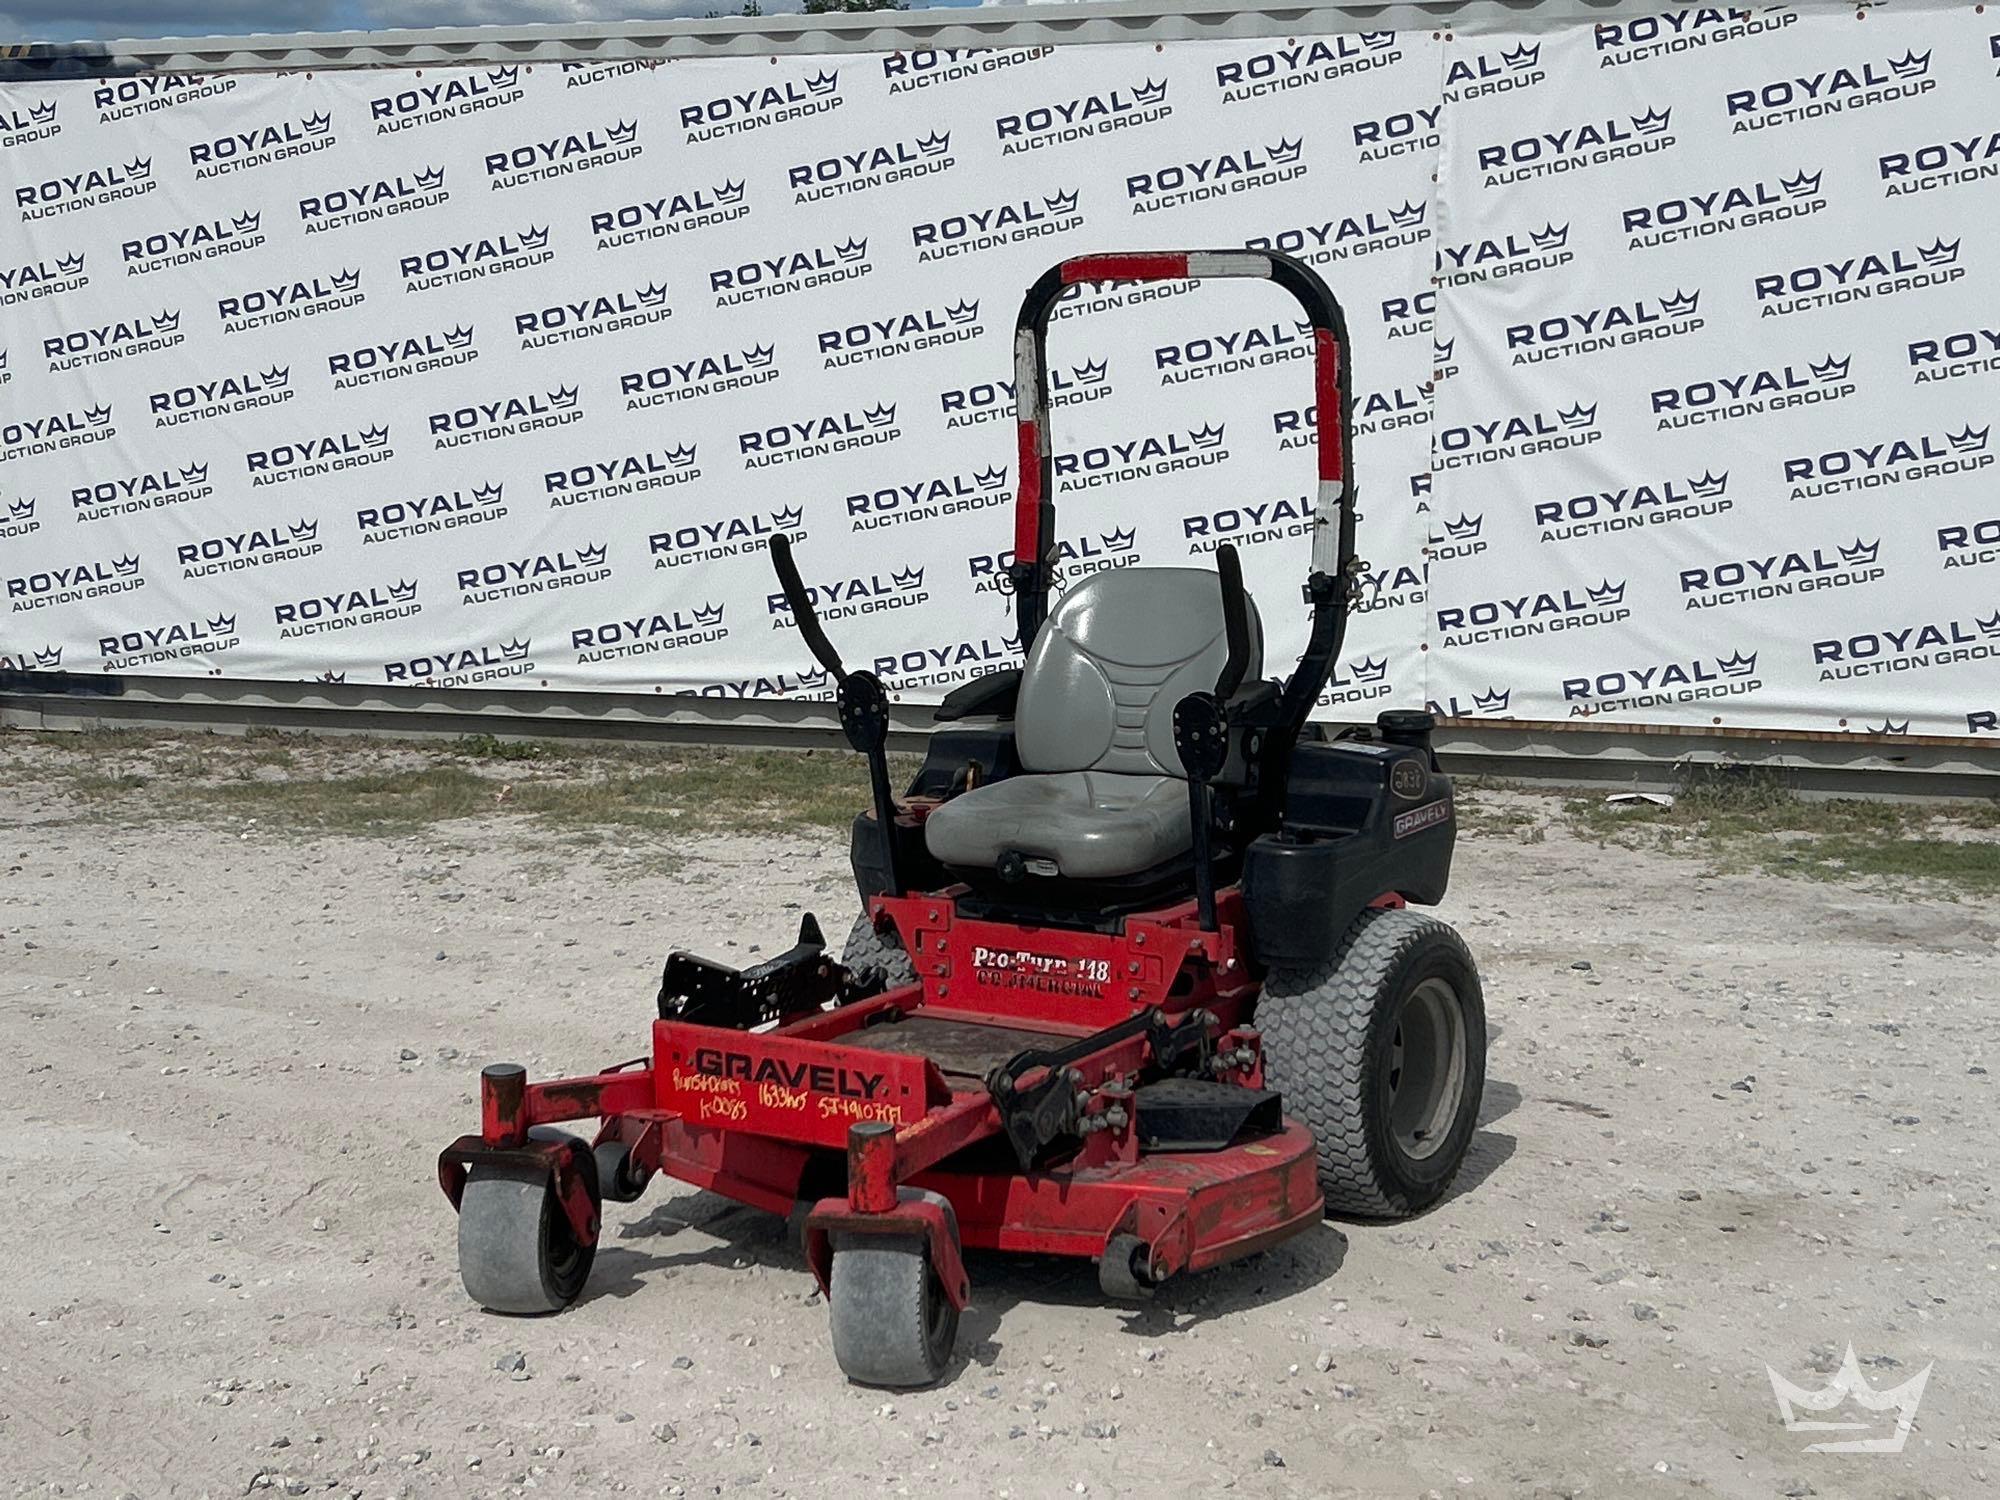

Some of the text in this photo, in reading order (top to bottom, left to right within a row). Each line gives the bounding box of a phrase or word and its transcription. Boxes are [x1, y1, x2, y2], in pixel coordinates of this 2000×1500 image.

[1216, 36, 1360, 87] ROYAL
[1222, 51, 1402, 104] AUCTION GROUP
[370, 76, 489, 120] ROYAL
[680, 82, 806, 128] ROYAL
[1727, 63, 1889, 116] ROYAL
[1733, 79, 1936, 134] AUCTION GROUP
[377, 90, 524, 135] AUCTION GROUP
[687, 97, 843, 144] AUCTION GROUP
[996, 91, 1132, 139] ROYAL
[1003, 106, 1172, 156] AUCTION GROUP
[189, 123, 302, 165] ROYAL
[196, 137, 335, 180] AUCTION GROUP
[485, 131, 607, 175] ROYAL
[1478, 120, 1631, 171] ROYAL
[1484, 136, 1675, 188] AUCTION GROUP
[16, 167, 125, 207] ROYAL
[492, 146, 642, 191] AUCTION GROUP
[789, 143, 917, 189] ROYAL
[795, 158, 955, 205] AUCTION GROUP
[1126, 150, 1266, 198] ROYAL
[22, 181, 156, 222] AUCTION GROUP
[299, 177, 415, 219] ROYAL
[1133, 165, 1307, 215] AUCTION GROUP
[1623, 183, 1780, 233] ROYAL
[305, 192, 449, 234] AUCTION GROUP
[591, 191, 714, 235] ROYAL
[597, 206, 750, 250] AUCTION GROUP
[912, 201, 1045, 247] ROYAL
[1629, 200, 1826, 251] AUCTION GROUP
[122, 221, 233, 262] ROYAL
[128, 235, 265, 276] AUCTION GROUP
[400, 236, 519, 278] ROYAL
[919, 216, 1083, 263] AUCTION GROUP
[406, 251, 554, 293] AUCTION GROUP
[710, 249, 835, 292] ROYAL
[716, 264, 872, 308] AUCTION GROUP
[1755, 251, 1917, 300] ROYAL
[218, 279, 332, 319] ROYAL
[224, 294, 365, 334] AUCTION GROUP
[515, 293, 637, 335] ROYAL
[1761, 268, 1965, 318] AUCTION GROUP
[43, 320, 153, 358] ROYAL
[522, 309, 672, 350] AUCTION GROUP
[818, 310, 946, 353] ROYAL
[1506, 301, 1660, 349] ROYAL
[1512, 319, 1704, 366] AUCTION GROUP
[49, 334, 184, 373] AUCTION GROUP
[328, 335, 445, 375] ROYAL
[824, 326, 984, 370] AUCTION GROUP
[1155, 324, 1295, 369] ROYAL
[335, 350, 478, 390] AUCTION GROUP
[621, 354, 743, 395] ROYAL
[627, 370, 779, 411] AUCTION GROUP
[1651, 367, 1809, 413] ROYAL
[149, 375, 262, 414] ROYAL
[156, 390, 293, 428] AUCTION GROUP
[429, 395, 549, 435] ROYAL
[1657, 384, 1855, 431] AUCTION GROUP
[435, 411, 583, 450] AUCTION GROUP
[739, 413, 864, 454] ROYAL
[745, 429, 901, 470] AUCTION GROUP
[1431, 413, 1558, 454] OYAL
[247, 434, 360, 472] ROYAL
[253, 450, 394, 487] AUCTION GROUP
[544, 454, 666, 493] ROYAL
[1054, 434, 1189, 476] ROYAL
[1060, 451, 1229, 493] AUCTION GROUP
[1784, 436, 1947, 483] ROYAL
[72, 471, 181, 508] ROYAL
[550, 469, 701, 508] AUCTION GROUP
[846, 476, 974, 516] ROYAL
[1790, 455, 1994, 501] AUCTION GROUP
[77, 487, 212, 523] AUCTION GROUP
[357, 492, 473, 530] ROYAL
[852, 492, 1012, 532] AUCTION GROUP
[1535, 482, 1688, 525] ROYAL
[1541, 500, 1733, 543] AUCTION GROUP
[177, 528, 289, 565] ROYAL
[363, 508, 507, 545] AUCTION GROUP
[649, 515, 772, 554] ROYAL
[7, 563, 113, 598] ROYAL
[184, 544, 322, 579] AUCTION GROUP
[457, 553, 577, 590] ROYAL
[1680, 549, 1838, 593] ROYAL
[12, 578, 145, 612] AUCTION GROUP
[275, 588, 389, 624] ROYAL
[463, 569, 611, 605] AUCTION GROUP
[1686, 568, 1884, 610] AUCTION GROUP
[280, 604, 421, 639] AUCTION GROUP
[572, 612, 693, 649] ROYAL
[1437, 590, 1587, 631] ROYAL
[1443, 609, 1630, 648] AUCTION GROUP
[99, 622, 208, 656] ROYAL
[577, 628, 728, 664] AUCTION GROUP
[1813, 621, 1976, 664] ROYAL
[1563, 661, 1717, 701] ROYAL
[1396, 803, 1446, 834] GRAVELY
[696, 1048, 884, 1098] GRAVELY
